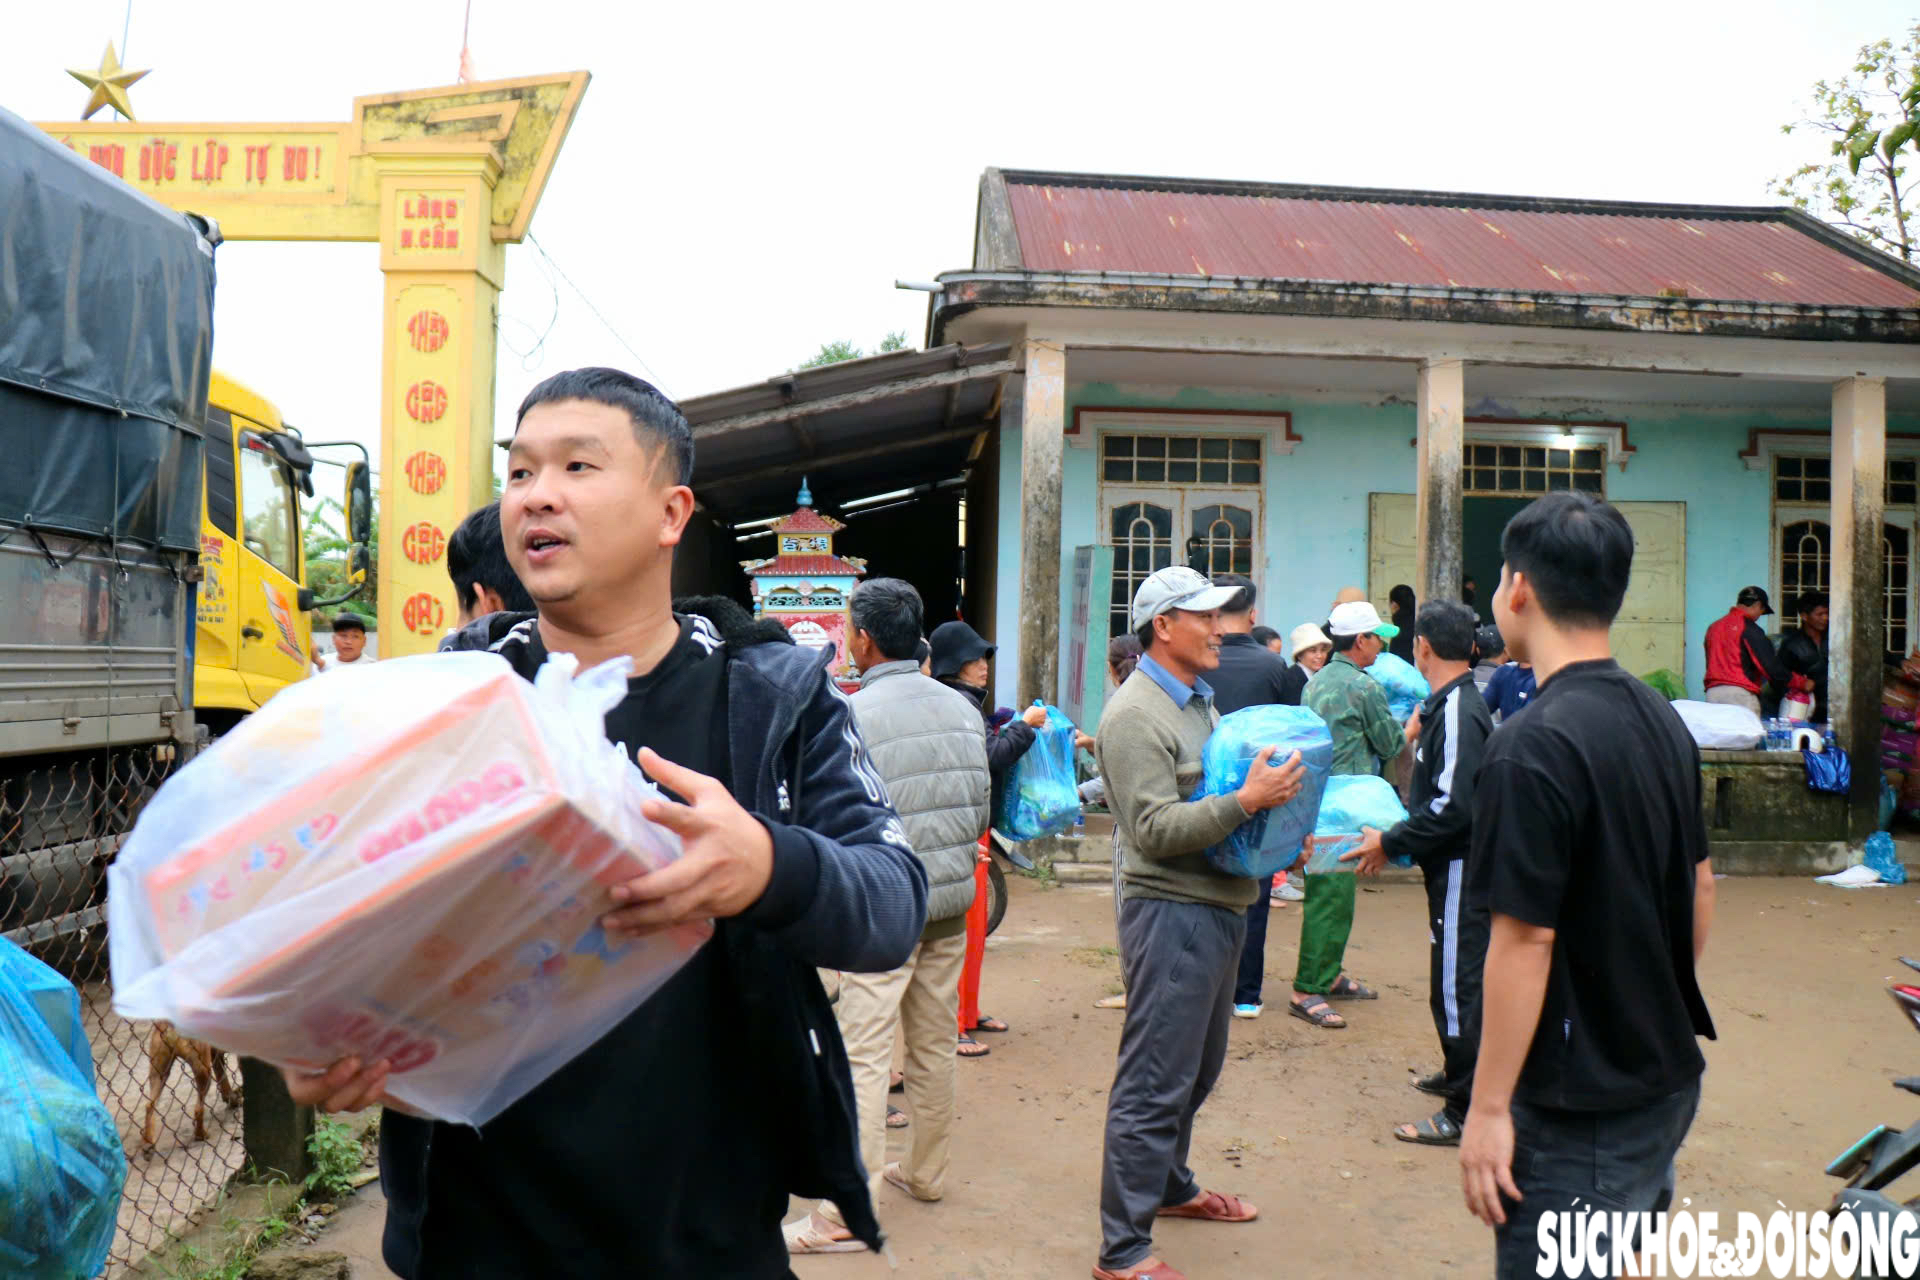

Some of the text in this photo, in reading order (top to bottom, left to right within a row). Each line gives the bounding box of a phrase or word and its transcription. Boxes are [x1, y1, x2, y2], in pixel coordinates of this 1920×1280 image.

[139, 137, 178, 186] ĐỘC
[191, 138, 229, 185] LẬP
[403, 192, 457, 219] LÀNG
